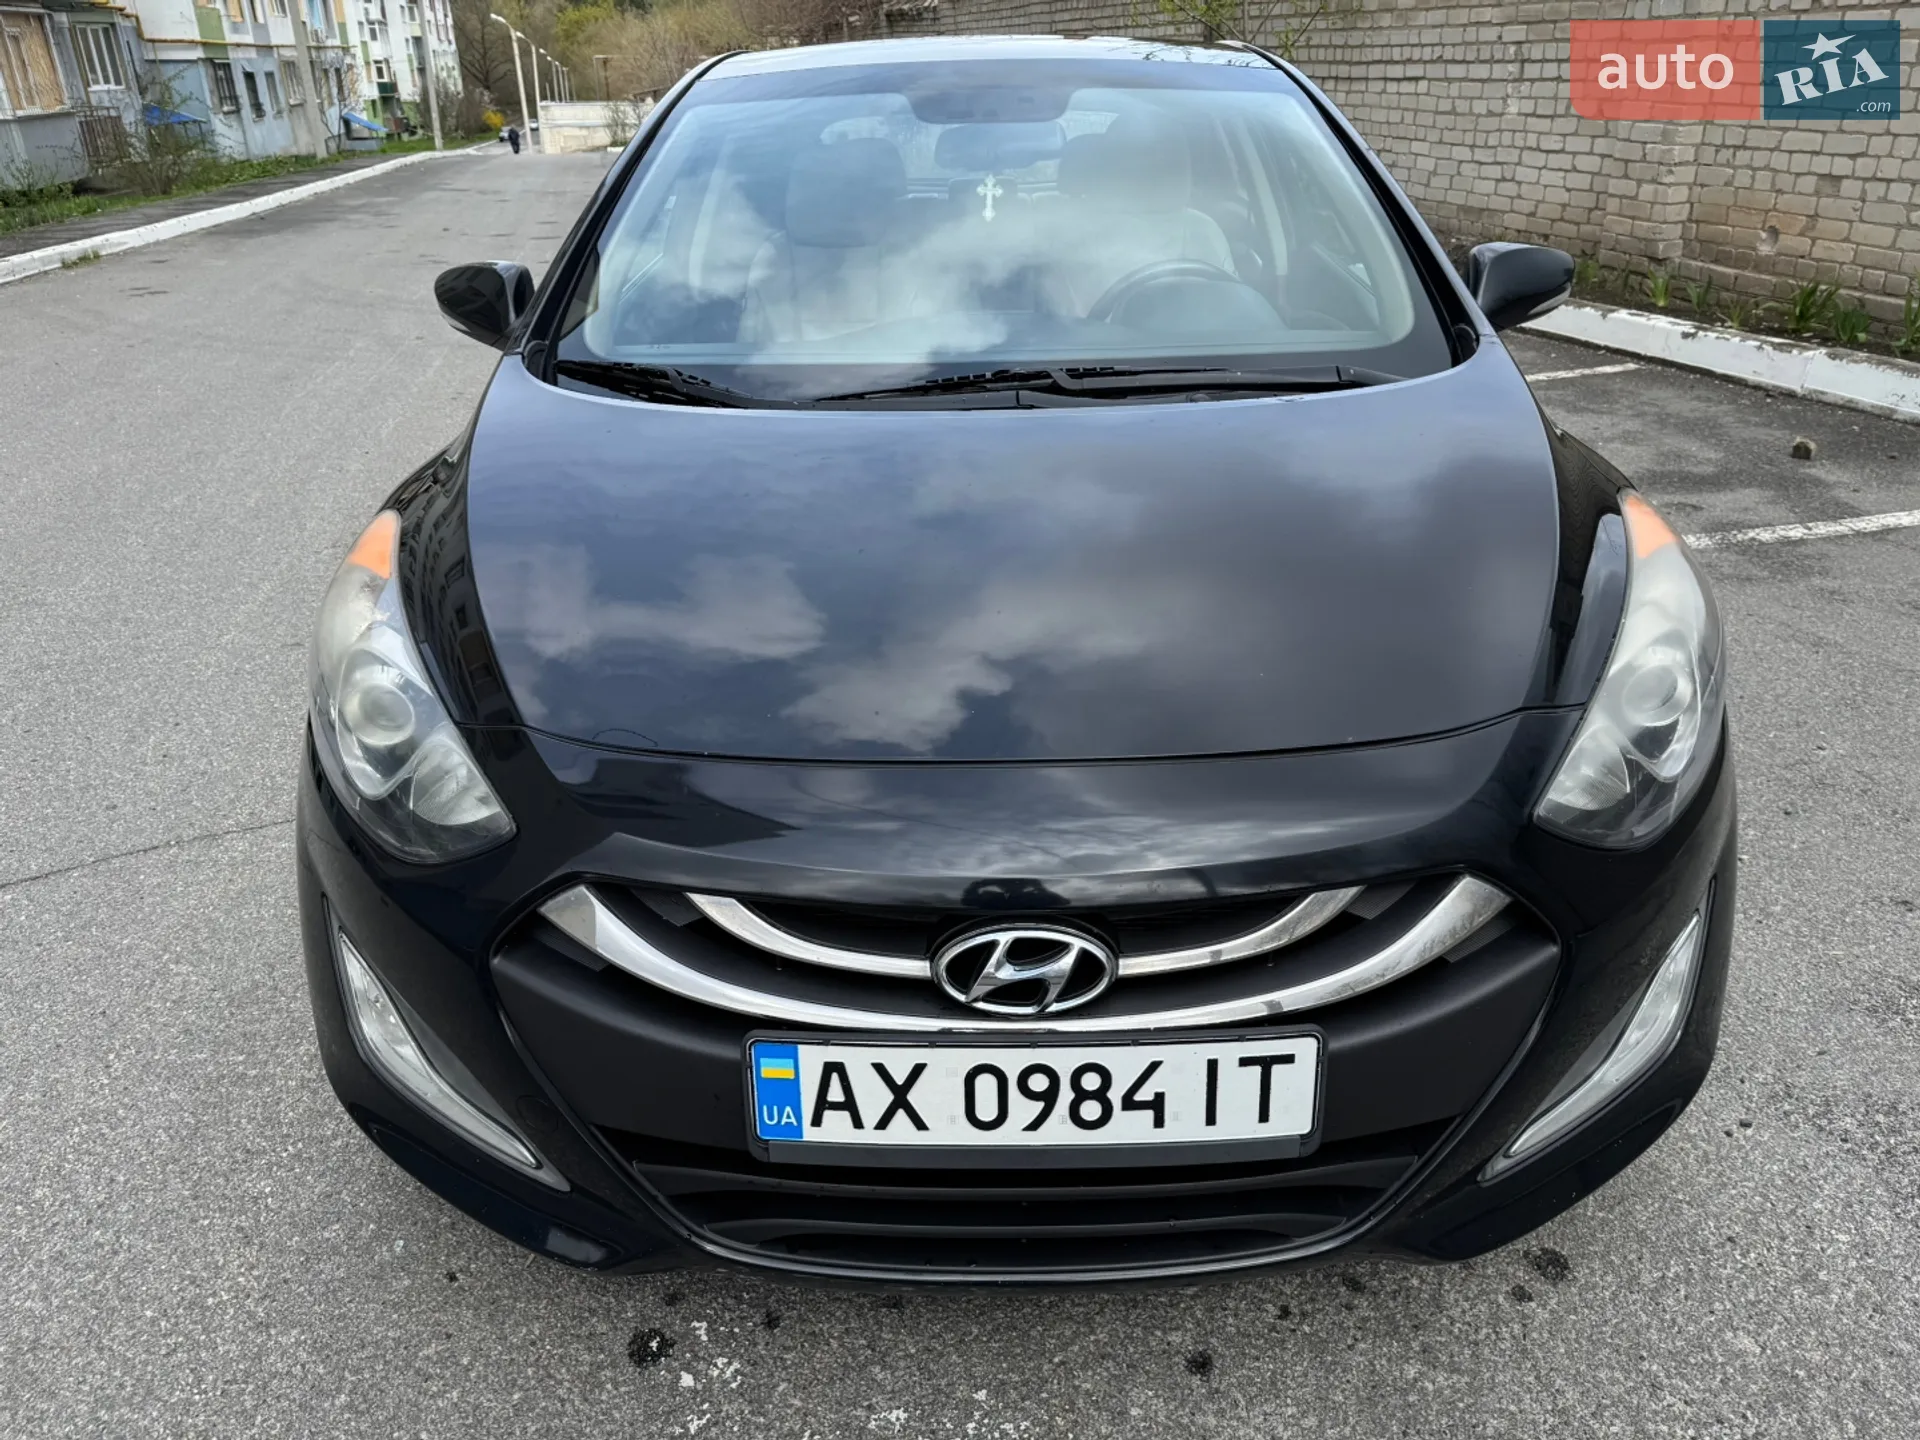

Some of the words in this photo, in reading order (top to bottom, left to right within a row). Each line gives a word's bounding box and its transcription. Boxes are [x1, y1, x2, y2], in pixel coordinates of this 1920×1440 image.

[763, 1106, 797, 1126] UA
[810, 1061, 929, 1131] AX
[963, 1060, 1165, 1131] 0984
[1205, 1053, 1296, 1126] IT
